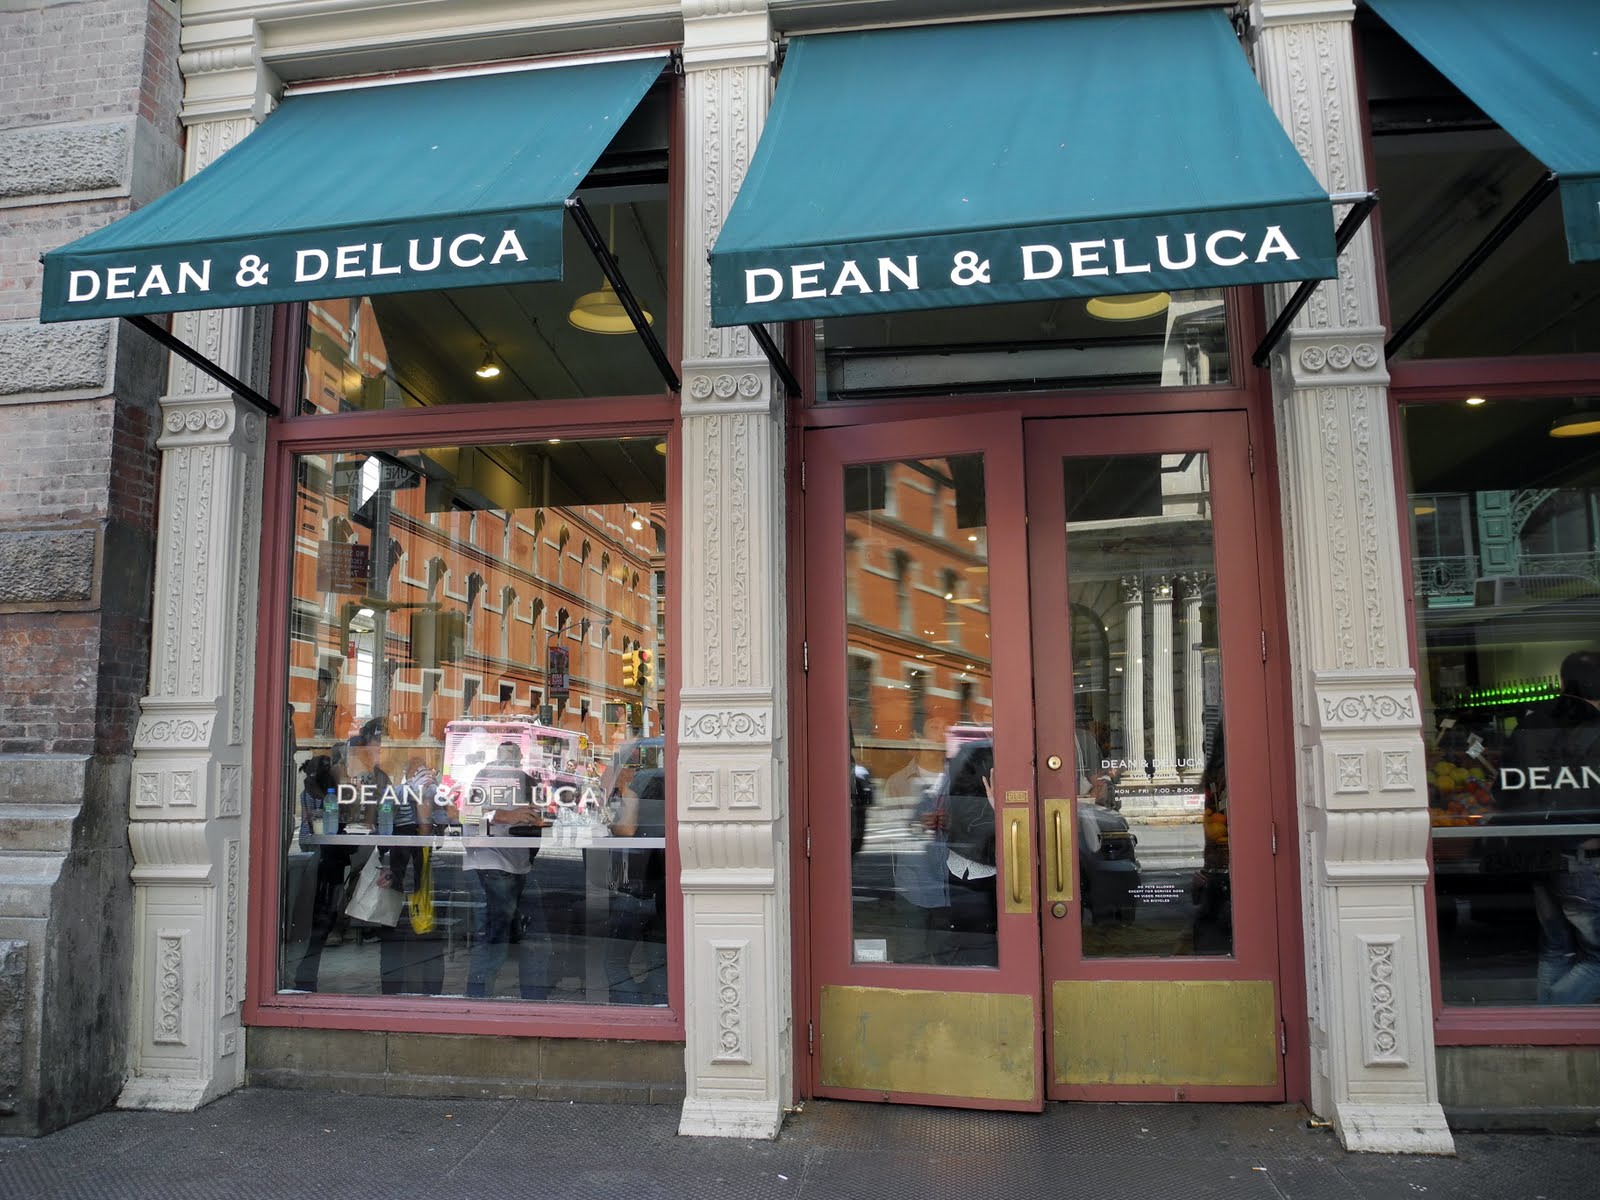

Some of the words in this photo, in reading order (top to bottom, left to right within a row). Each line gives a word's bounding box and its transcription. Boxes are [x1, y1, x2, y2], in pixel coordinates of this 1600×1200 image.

[67, 259, 212, 303] DEAN
[235, 254, 270, 288] &
[294, 229, 529, 283] DELUCA
[744, 254, 920, 304] DEAN
[950, 250, 991, 286] &
[1020, 225, 1301, 282] DELUCA
[1101, 759, 1136, 769] DEAN
[1141, 759, 1149, 768] &
[1152, 758, 1204, 768] DELUCA
[1499, 766, 1600, 791] DEAN
[336, 784, 424, 805] DEAN
[433, 783, 455, 807] &
[465, 785, 600, 807] DELUCA
